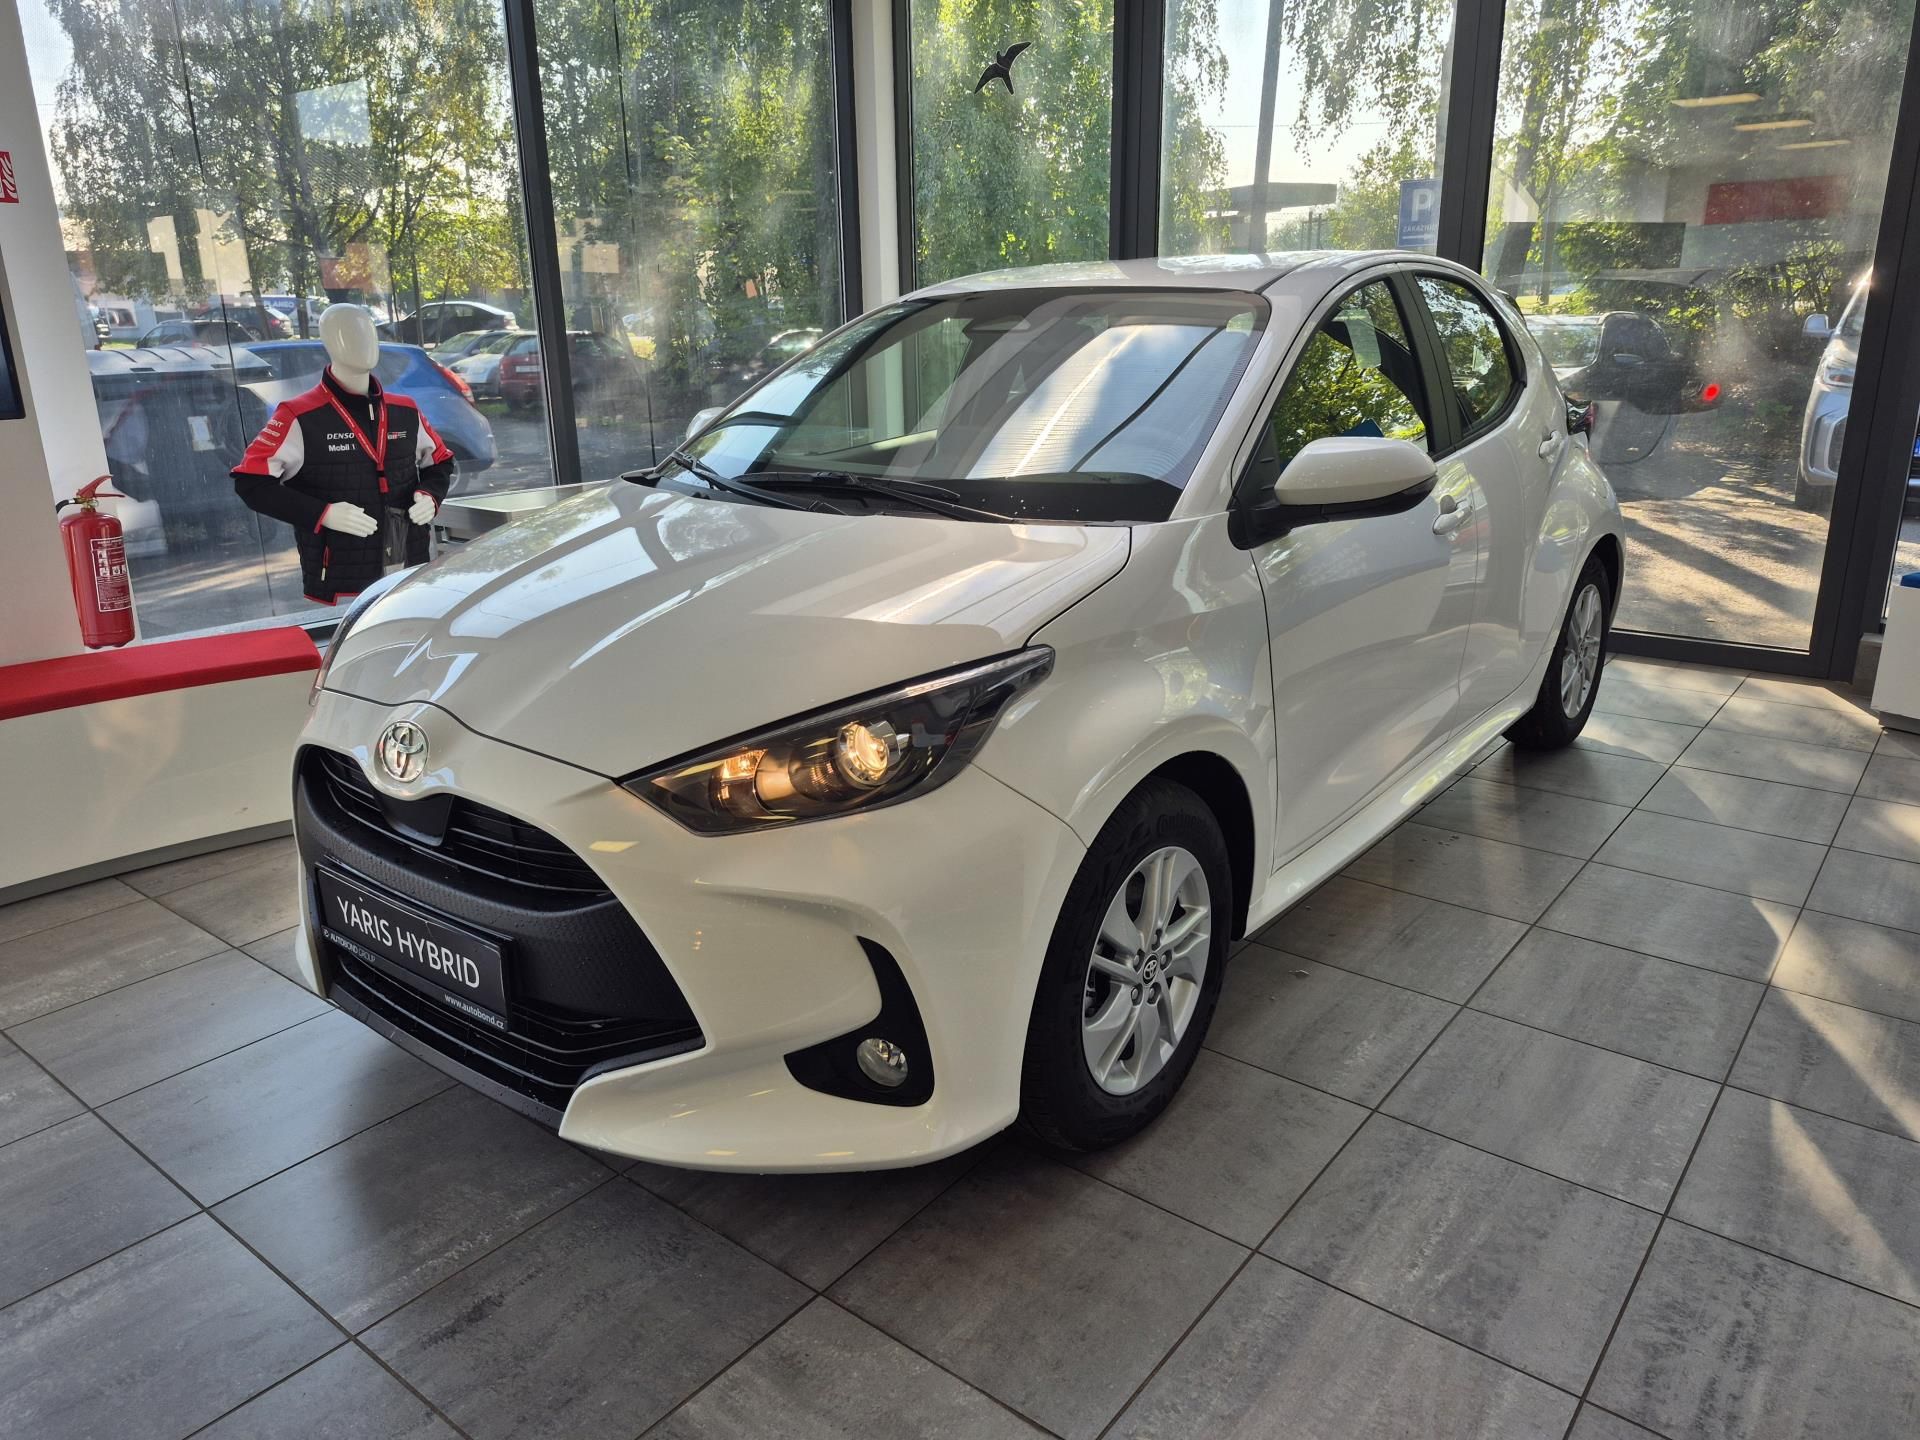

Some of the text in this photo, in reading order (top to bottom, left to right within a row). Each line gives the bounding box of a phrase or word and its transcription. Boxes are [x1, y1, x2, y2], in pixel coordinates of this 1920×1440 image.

[1411, 188, 1432, 222] P
[326, 432, 355, 440] DENSO
[328, 443, 350, 452] Mobil
[337, 896, 480, 989] YARIS HYBRID
[444, 993, 505, 1030] www.autobond.cz
